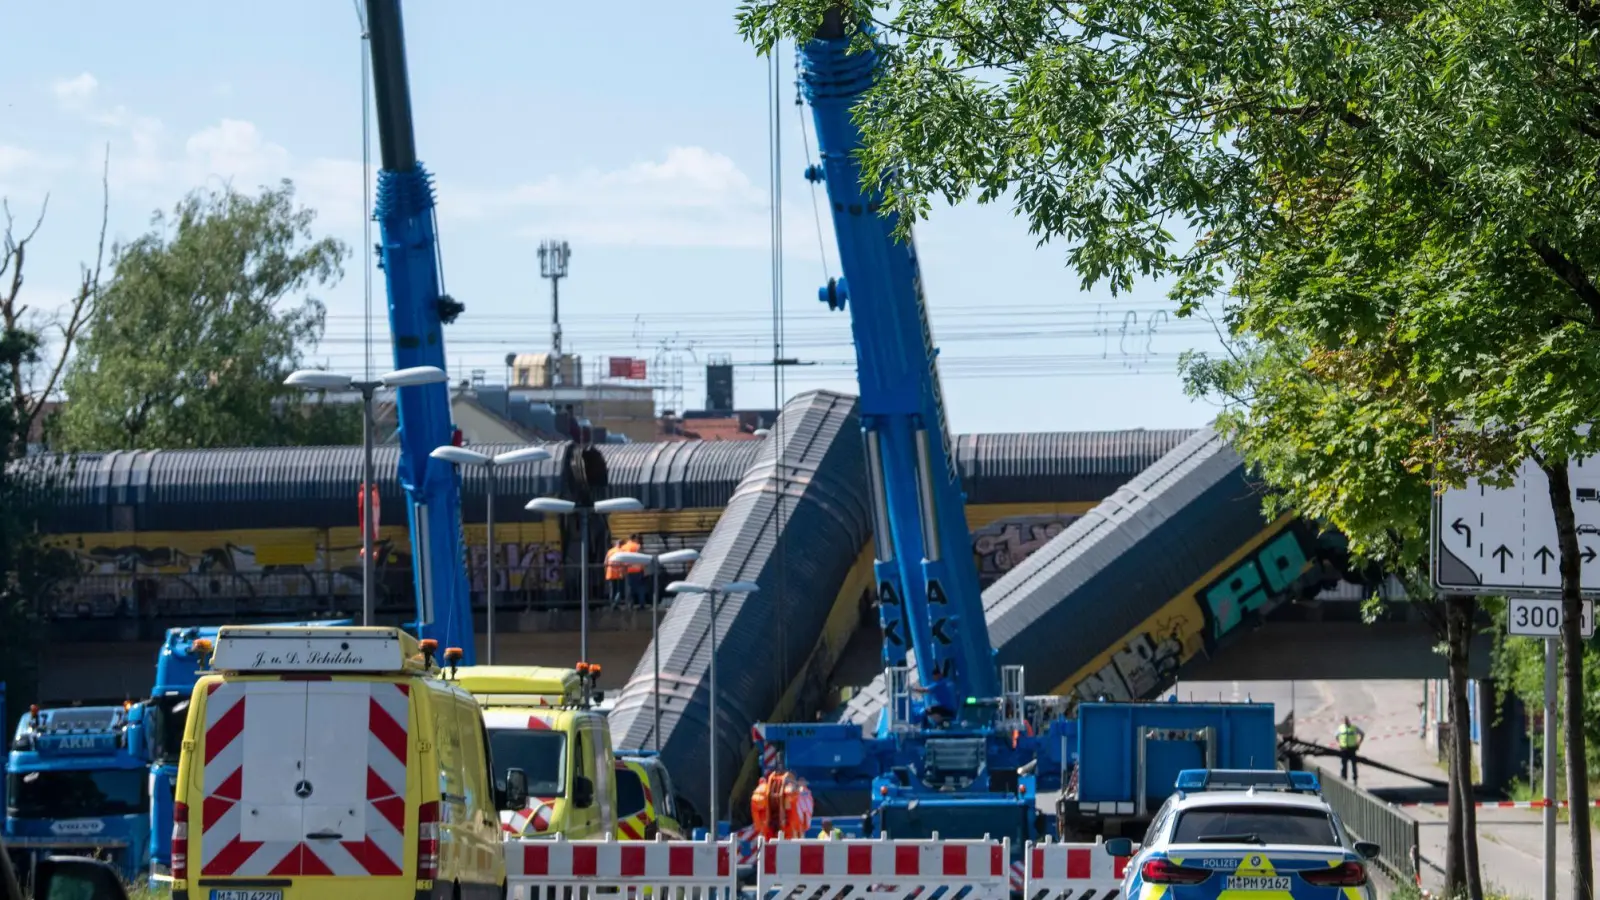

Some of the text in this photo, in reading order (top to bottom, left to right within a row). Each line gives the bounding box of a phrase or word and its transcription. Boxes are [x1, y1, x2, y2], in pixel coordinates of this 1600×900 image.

[1516, 606, 1559, 628] 300
[307, 651, 364, 665] Schilcher
[59, 737, 95, 749] AKM
[58, 822, 99, 831] VOLVO
[1203, 859, 1238, 868] POLIZEI
[1260, 878, 1289, 889] 9162
